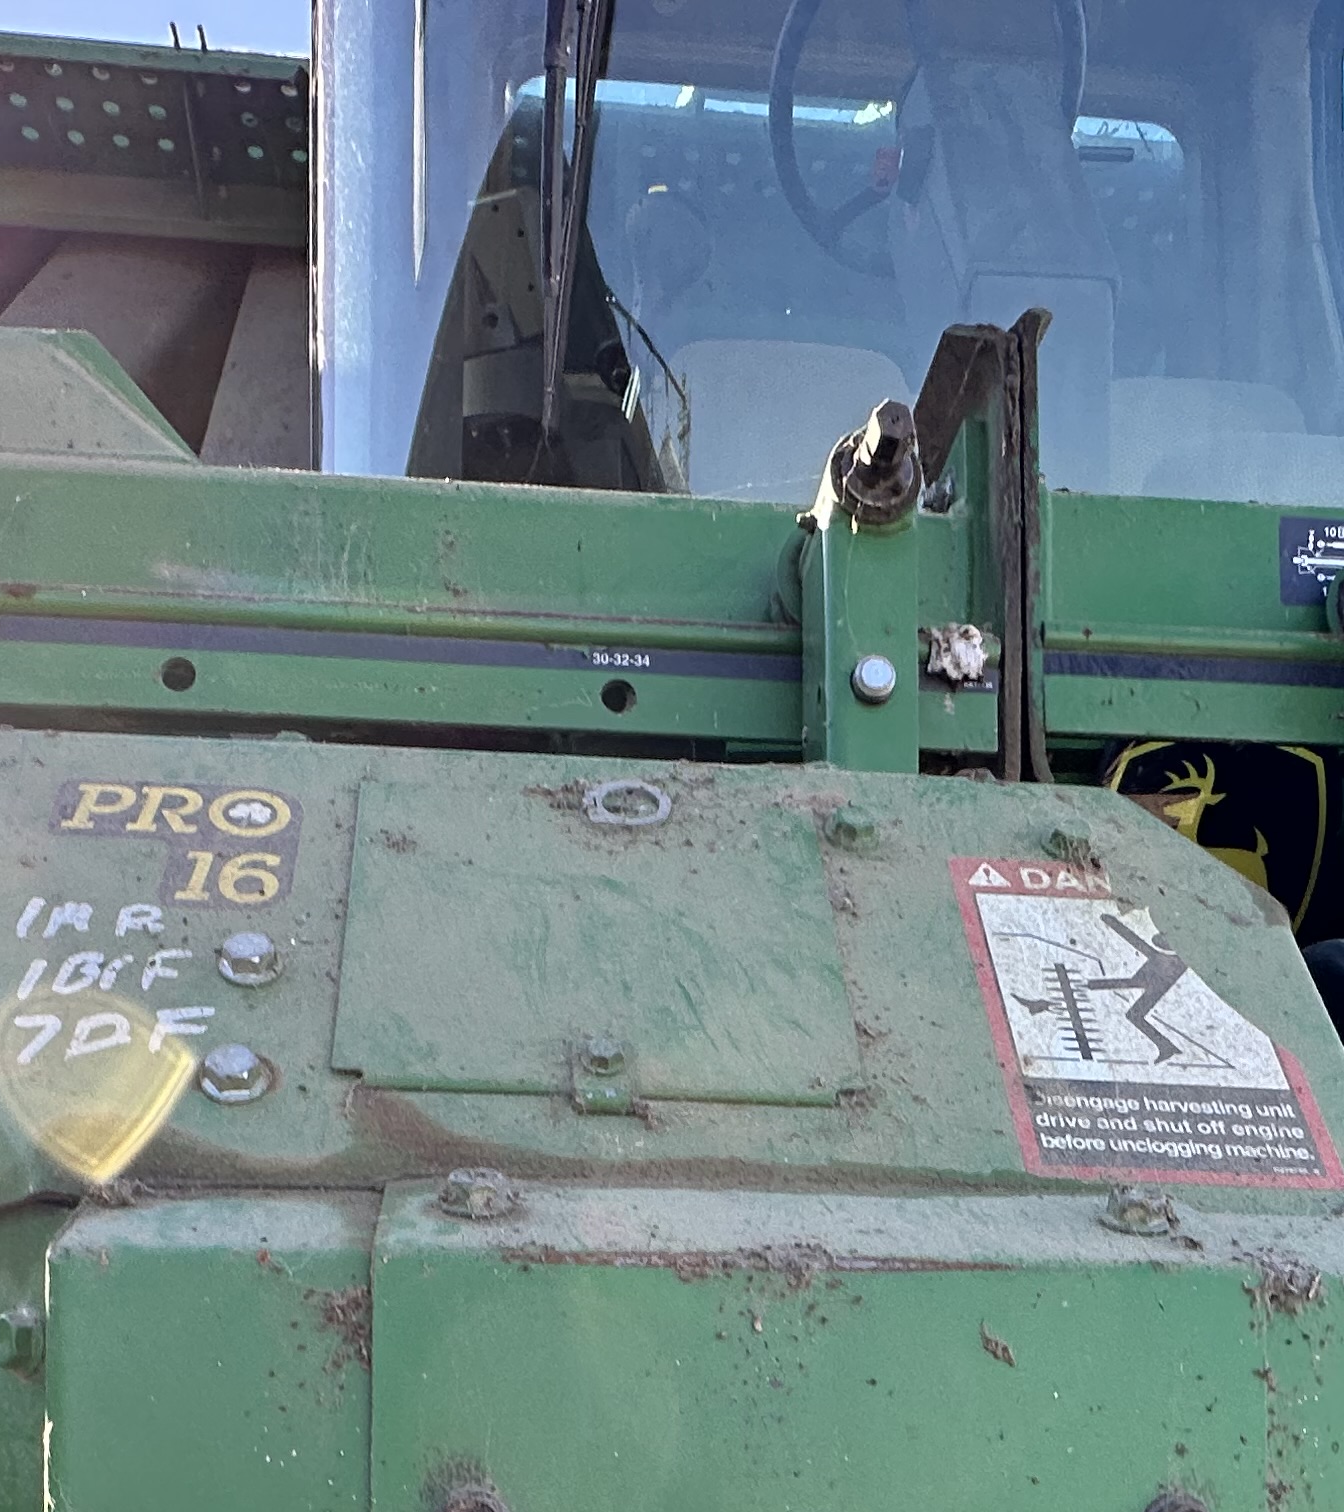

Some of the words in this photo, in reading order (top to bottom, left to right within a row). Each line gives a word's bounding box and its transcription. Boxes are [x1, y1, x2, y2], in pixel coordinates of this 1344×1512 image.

[60, 781, 292, 838] PRO
[173, 849, 282, 904] 16
[148, 1005, 216, 1055] F
[1036, 1112, 1091, 1130] drive
[1096, 1116, 1138, 1131] and
[1143, 1116, 1193, 1135] shut
[1196, 1119, 1227, 1136] off
[1231, 1122, 1305, 1141] engine
[1143, 1095, 1253, 1120] harvesting
[1255, 1102, 1297, 1119] unit
[1040, 1132, 1106, 1152] before
[1108, 1137, 1224, 1160] unclogging
[1224, 1143, 1316, 1162] machine.
